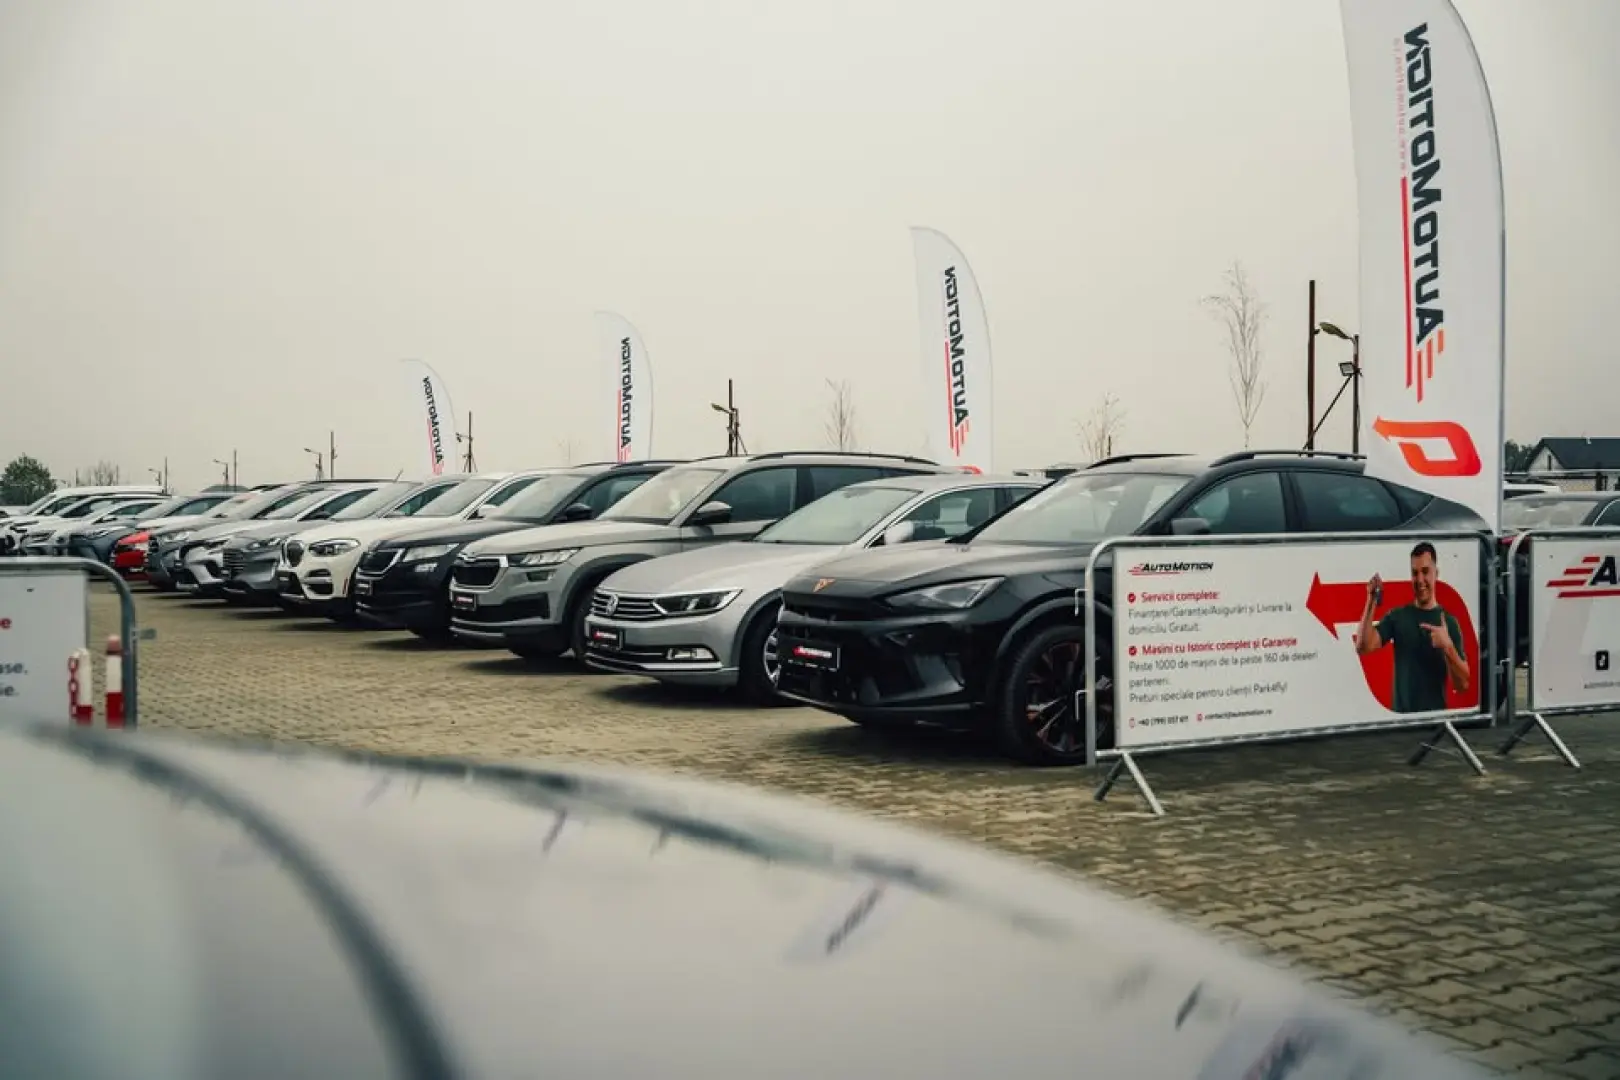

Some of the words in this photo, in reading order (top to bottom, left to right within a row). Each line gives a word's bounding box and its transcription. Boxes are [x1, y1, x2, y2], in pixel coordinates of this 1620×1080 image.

[1175, 645, 1185, 654] cu
[1155, 659, 1177, 670] 1000
[1177, 658, 1189, 669] de
[1218, 655, 1229, 666] de
[1264, 652, 1278, 662] 160
[1279, 653, 1290, 662] de
